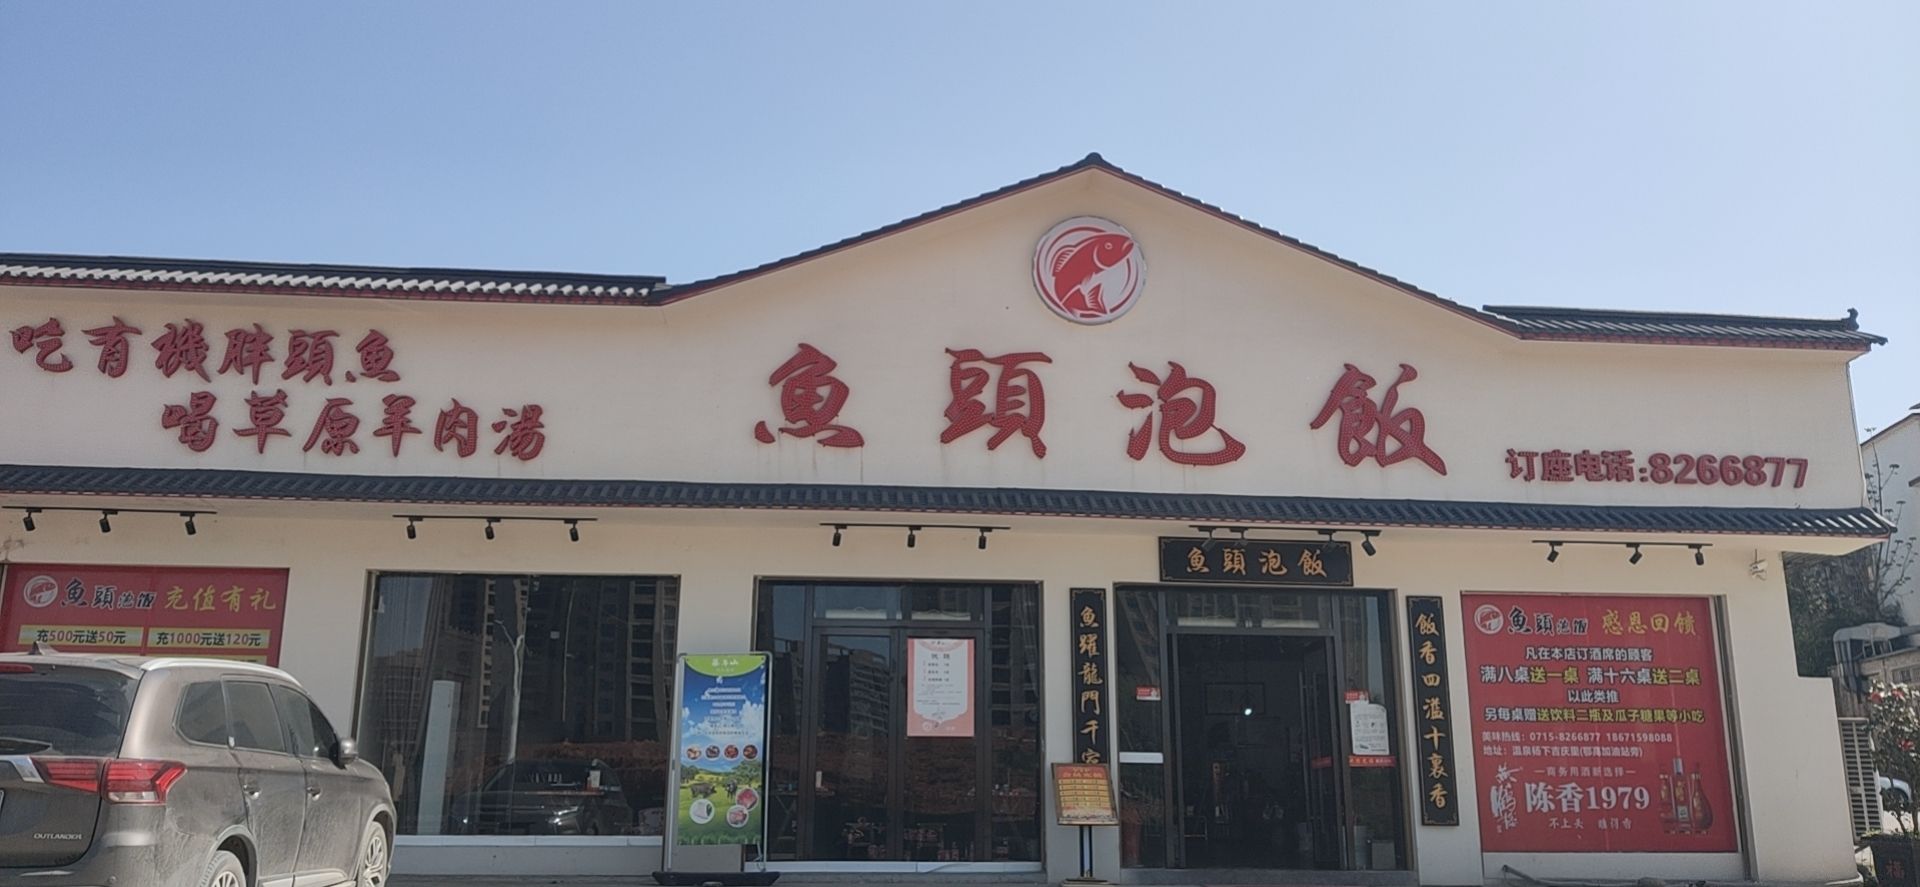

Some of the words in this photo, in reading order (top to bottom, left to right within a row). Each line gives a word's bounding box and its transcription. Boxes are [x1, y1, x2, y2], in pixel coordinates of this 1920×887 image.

[9, 316, 402, 385] 吃有機胖頭魚
[754, 343, 1447, 476] 魚頭泡飯
[161, 389, 547, 462] 喝草原羊肉湯
[1186, 547, 1328, 578] 魚頭泡飯
[164, 585, 277, 612] 充值有礼
[36, 628, 127, 645] 充500元送50元
[156, 631, 262, 647] 充1000元送120元
[1525, 647, 1654, 663] 凡在本店订酒席的顾客
[1480, 666, 1580, 684] 满八桌送一桌
[1587, 668, 1700, 686] 满十六桌送二桌
[1567, 689, 1620, 704] 以此类推
[1524, 781, 1650, 813] 陈香1979
[33, 832, 83, 841] OUTLANDER
